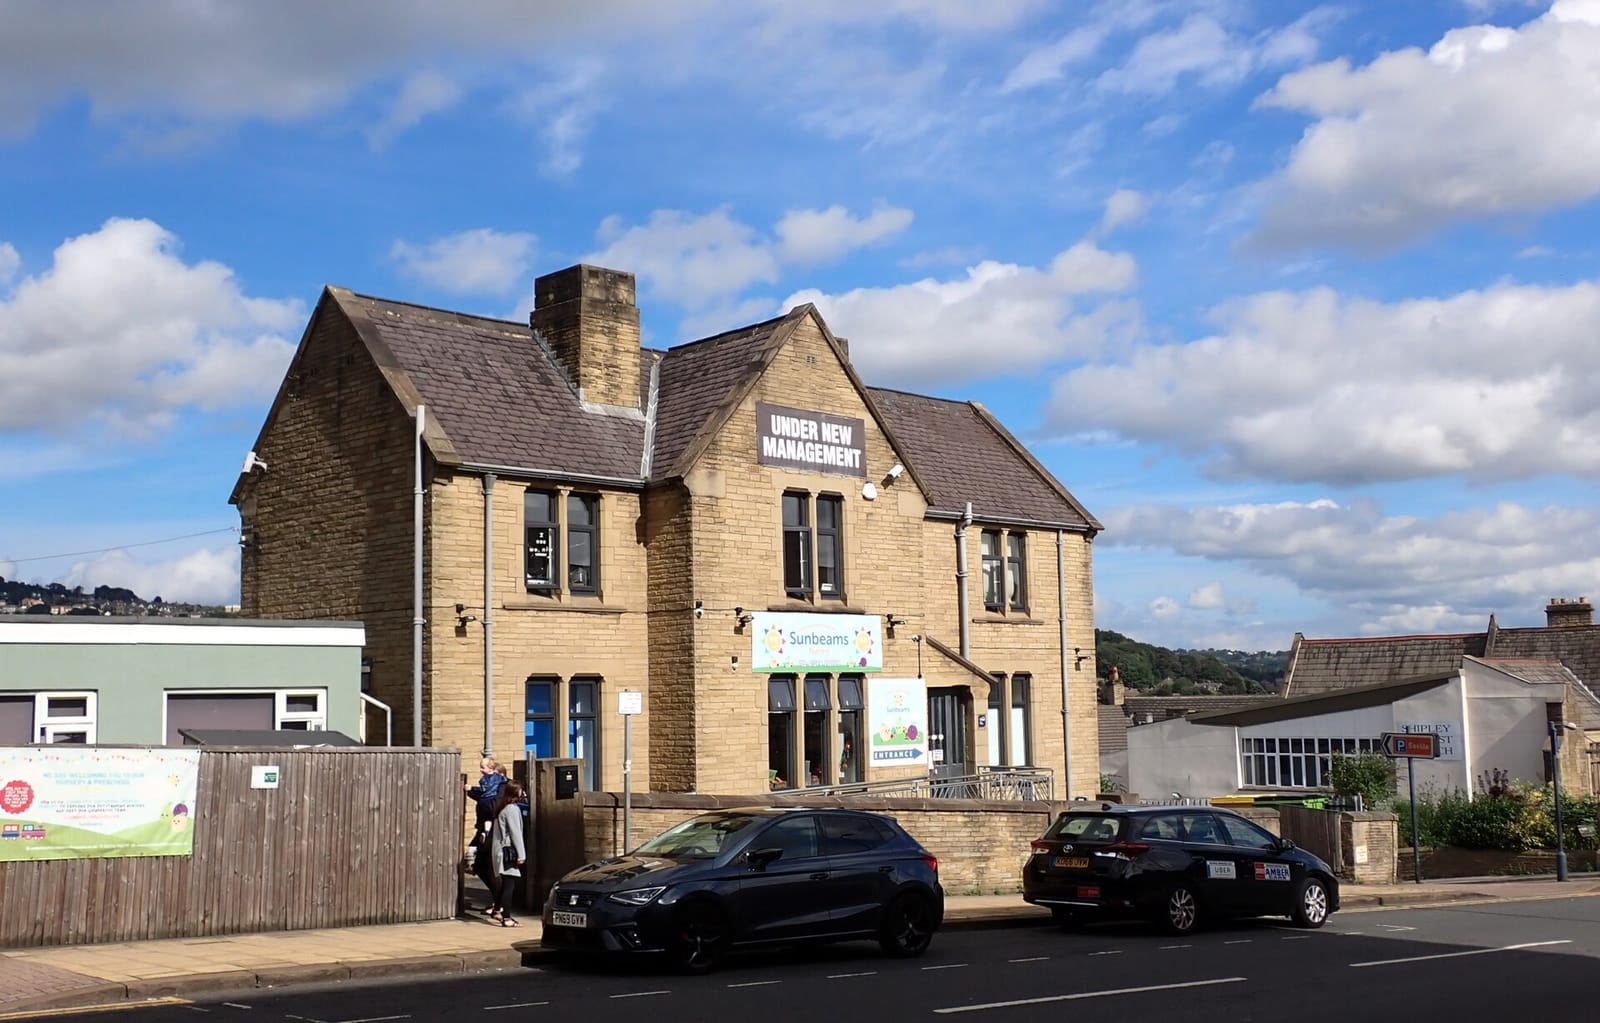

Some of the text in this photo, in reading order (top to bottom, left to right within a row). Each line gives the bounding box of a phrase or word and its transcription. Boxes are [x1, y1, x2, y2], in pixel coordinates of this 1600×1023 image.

[771, 414, 852, 446] UNDER NEW
[762, 435, 862, 469] MANAGEMENT
[789, 631, 849, 646] Sunbeams
[1401, 724, 1450, 733] SHIPLEY
[874, 750, 912, 759] ENTRANCE
